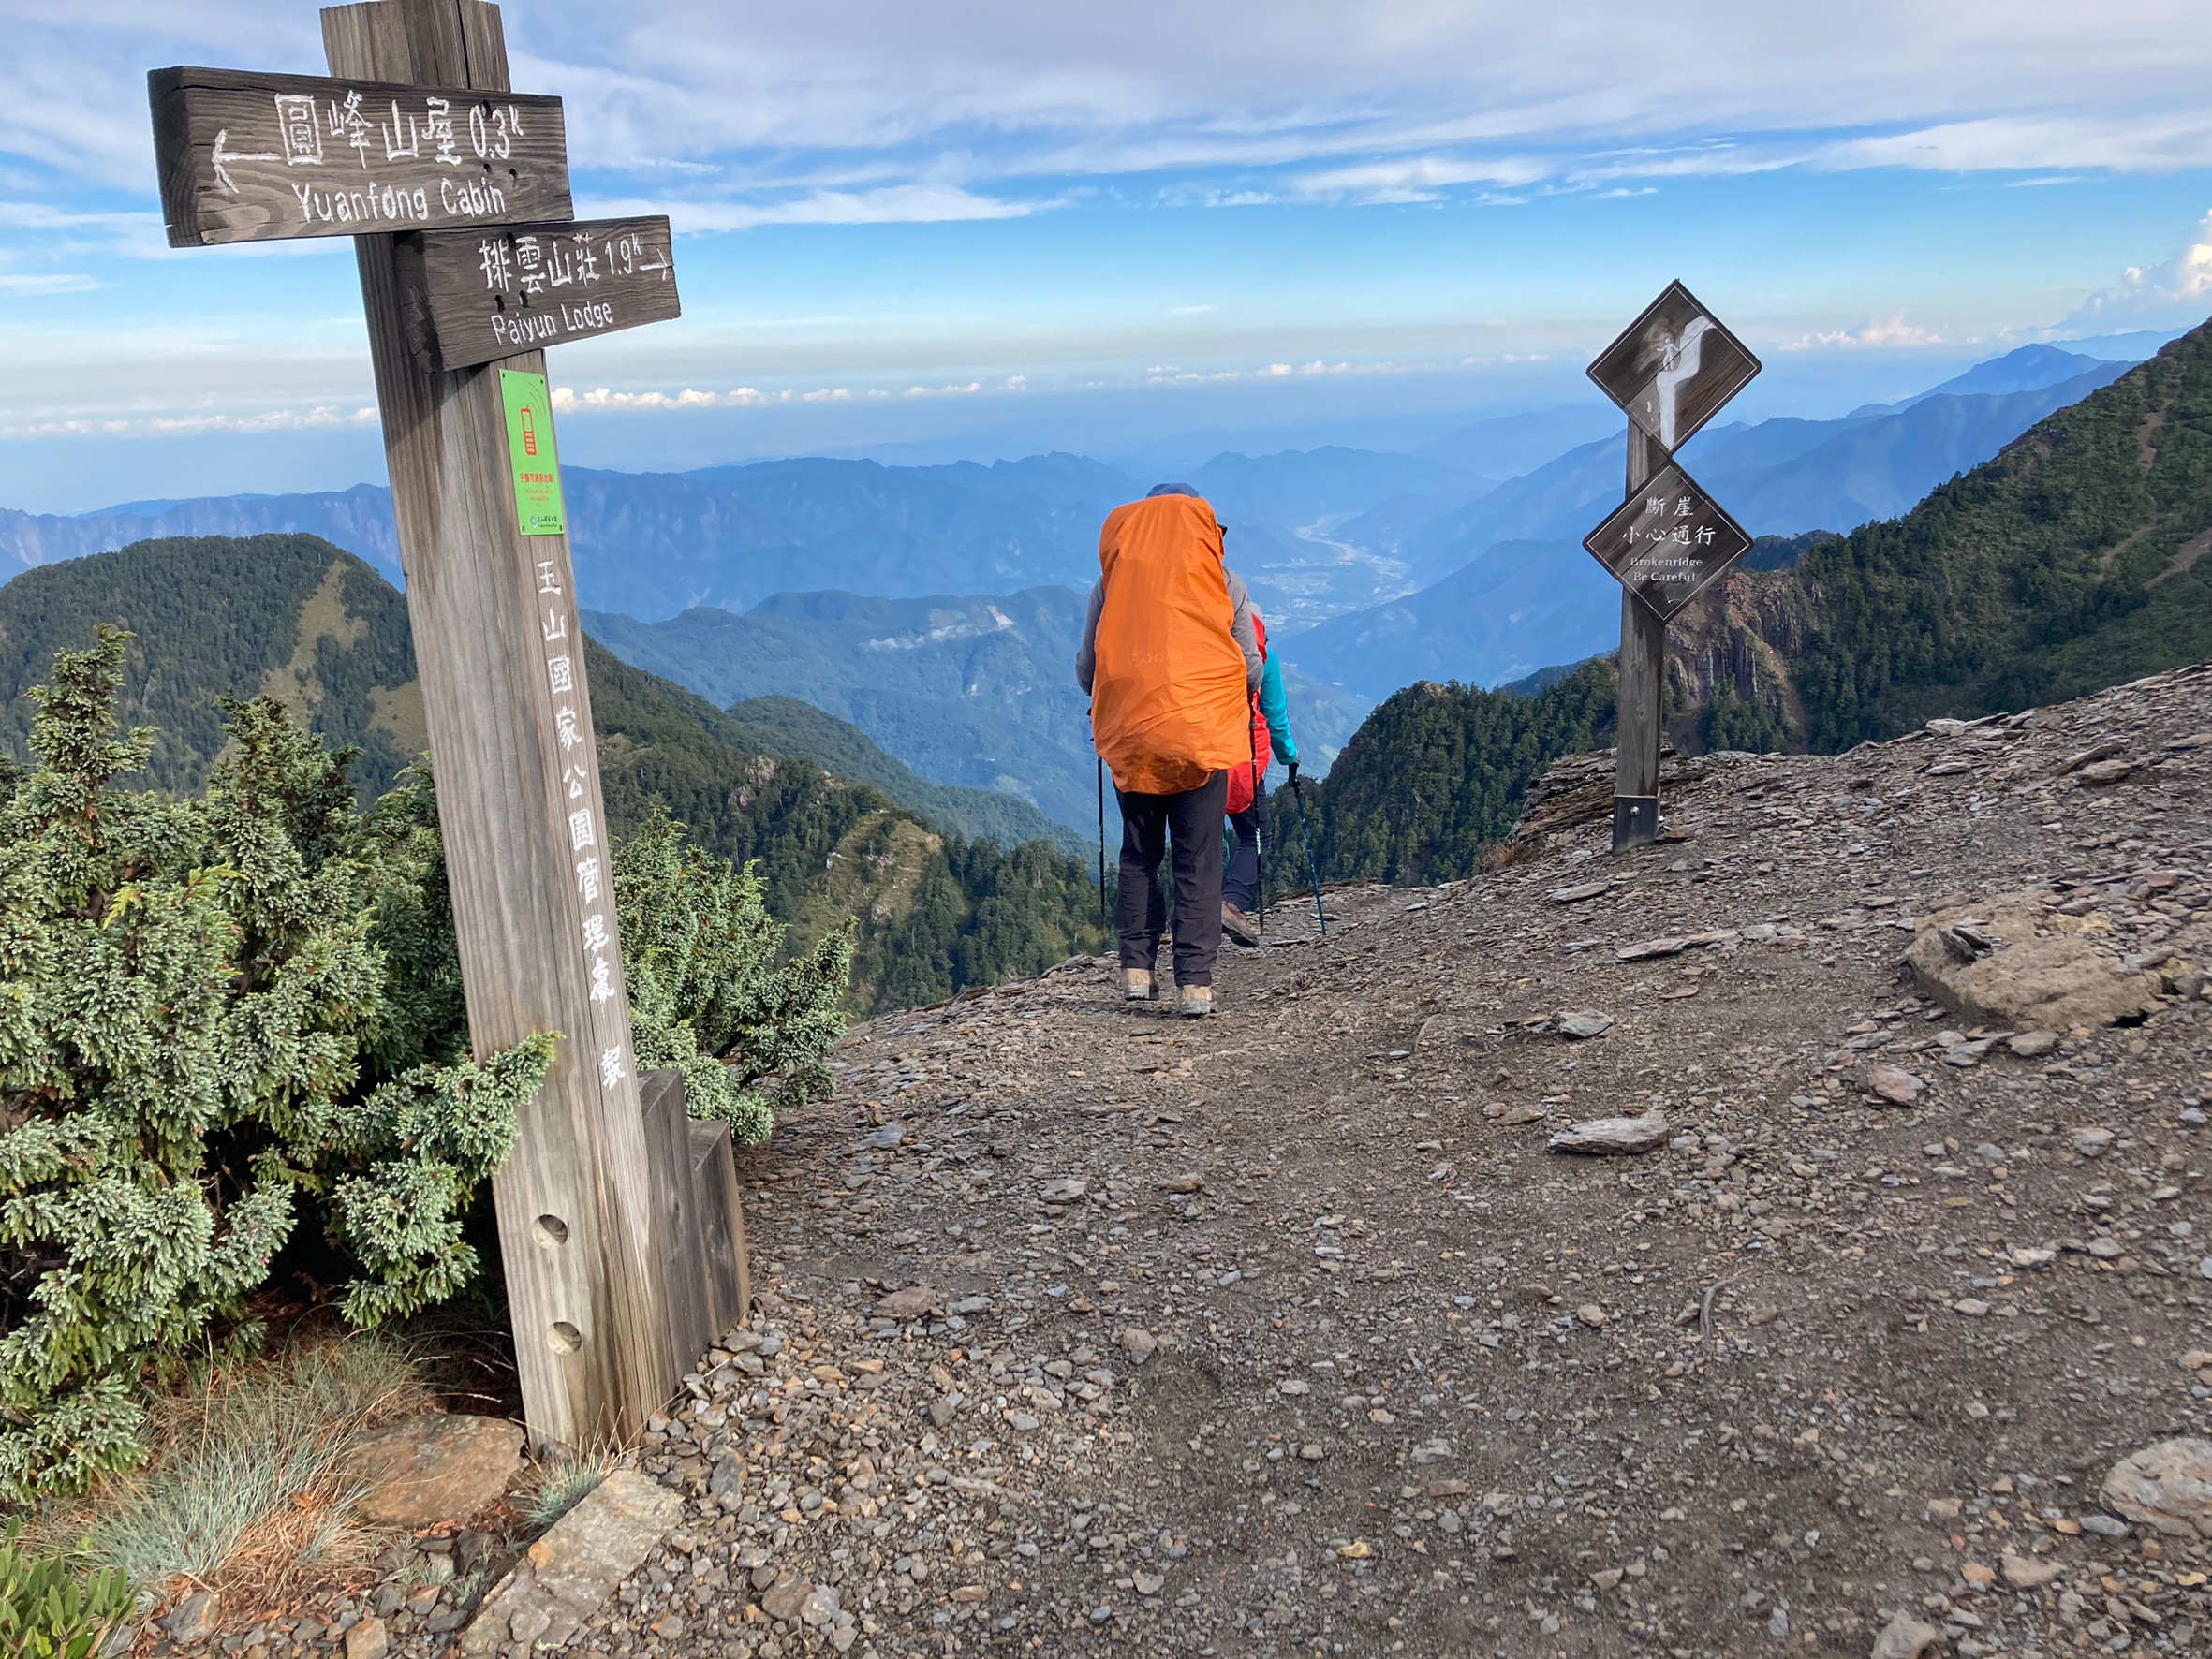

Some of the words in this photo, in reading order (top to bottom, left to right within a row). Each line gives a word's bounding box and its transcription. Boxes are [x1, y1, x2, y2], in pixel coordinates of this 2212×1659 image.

[275, 90, 462, 169] 圓峰山屋
[291, 182, 429, 223] Yuanfong
[441, 177, 506, 217] Cabin
[490, 312, 558, 346] Paiyun
[562, 300, 614, 330] Lodge
[1645, 496, 1694, 517] 斷崖
[1622, 525, 1717, 547] 小心通行
[1630, 557, 1703, 568] Brokenridge
[1632, 572, 1648, 582] Be
[1650, 571, 1696, 582] Careful
